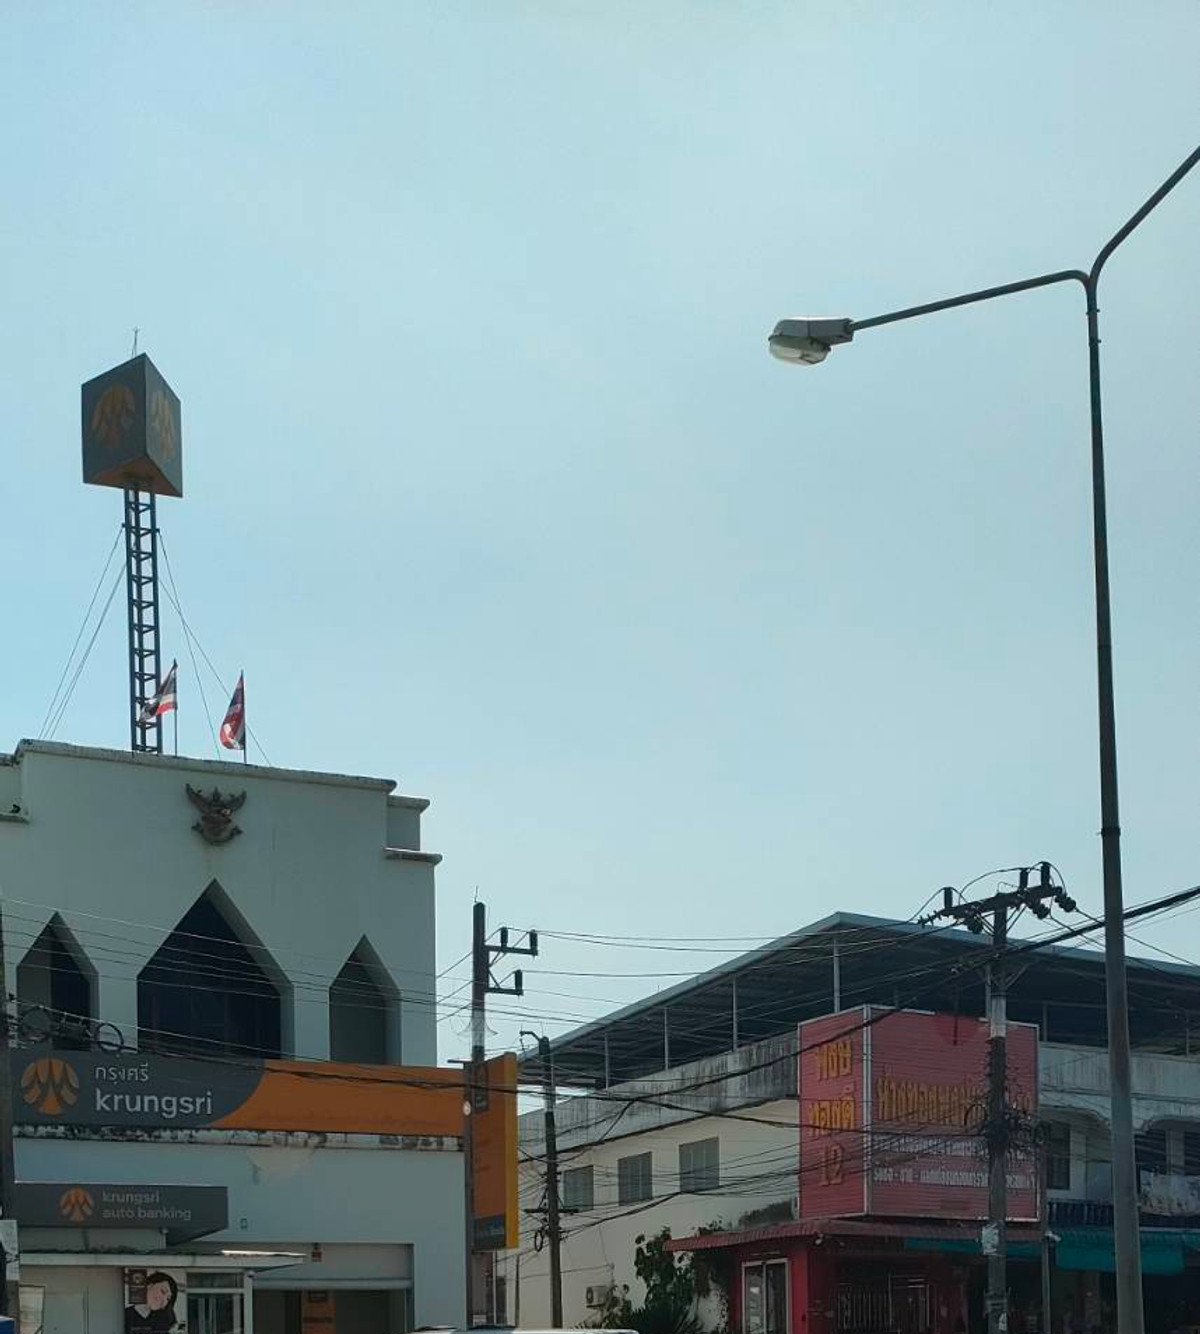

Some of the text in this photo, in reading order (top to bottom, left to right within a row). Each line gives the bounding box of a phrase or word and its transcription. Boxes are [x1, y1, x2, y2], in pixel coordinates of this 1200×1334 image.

[95, 1063, 150, 1085] กรุงศรี
[96, 1088, 212, 1119] krungsri
[102, 1190, 160, 1204] krungsri
[102, 1207, 192, 1220] auto banking
